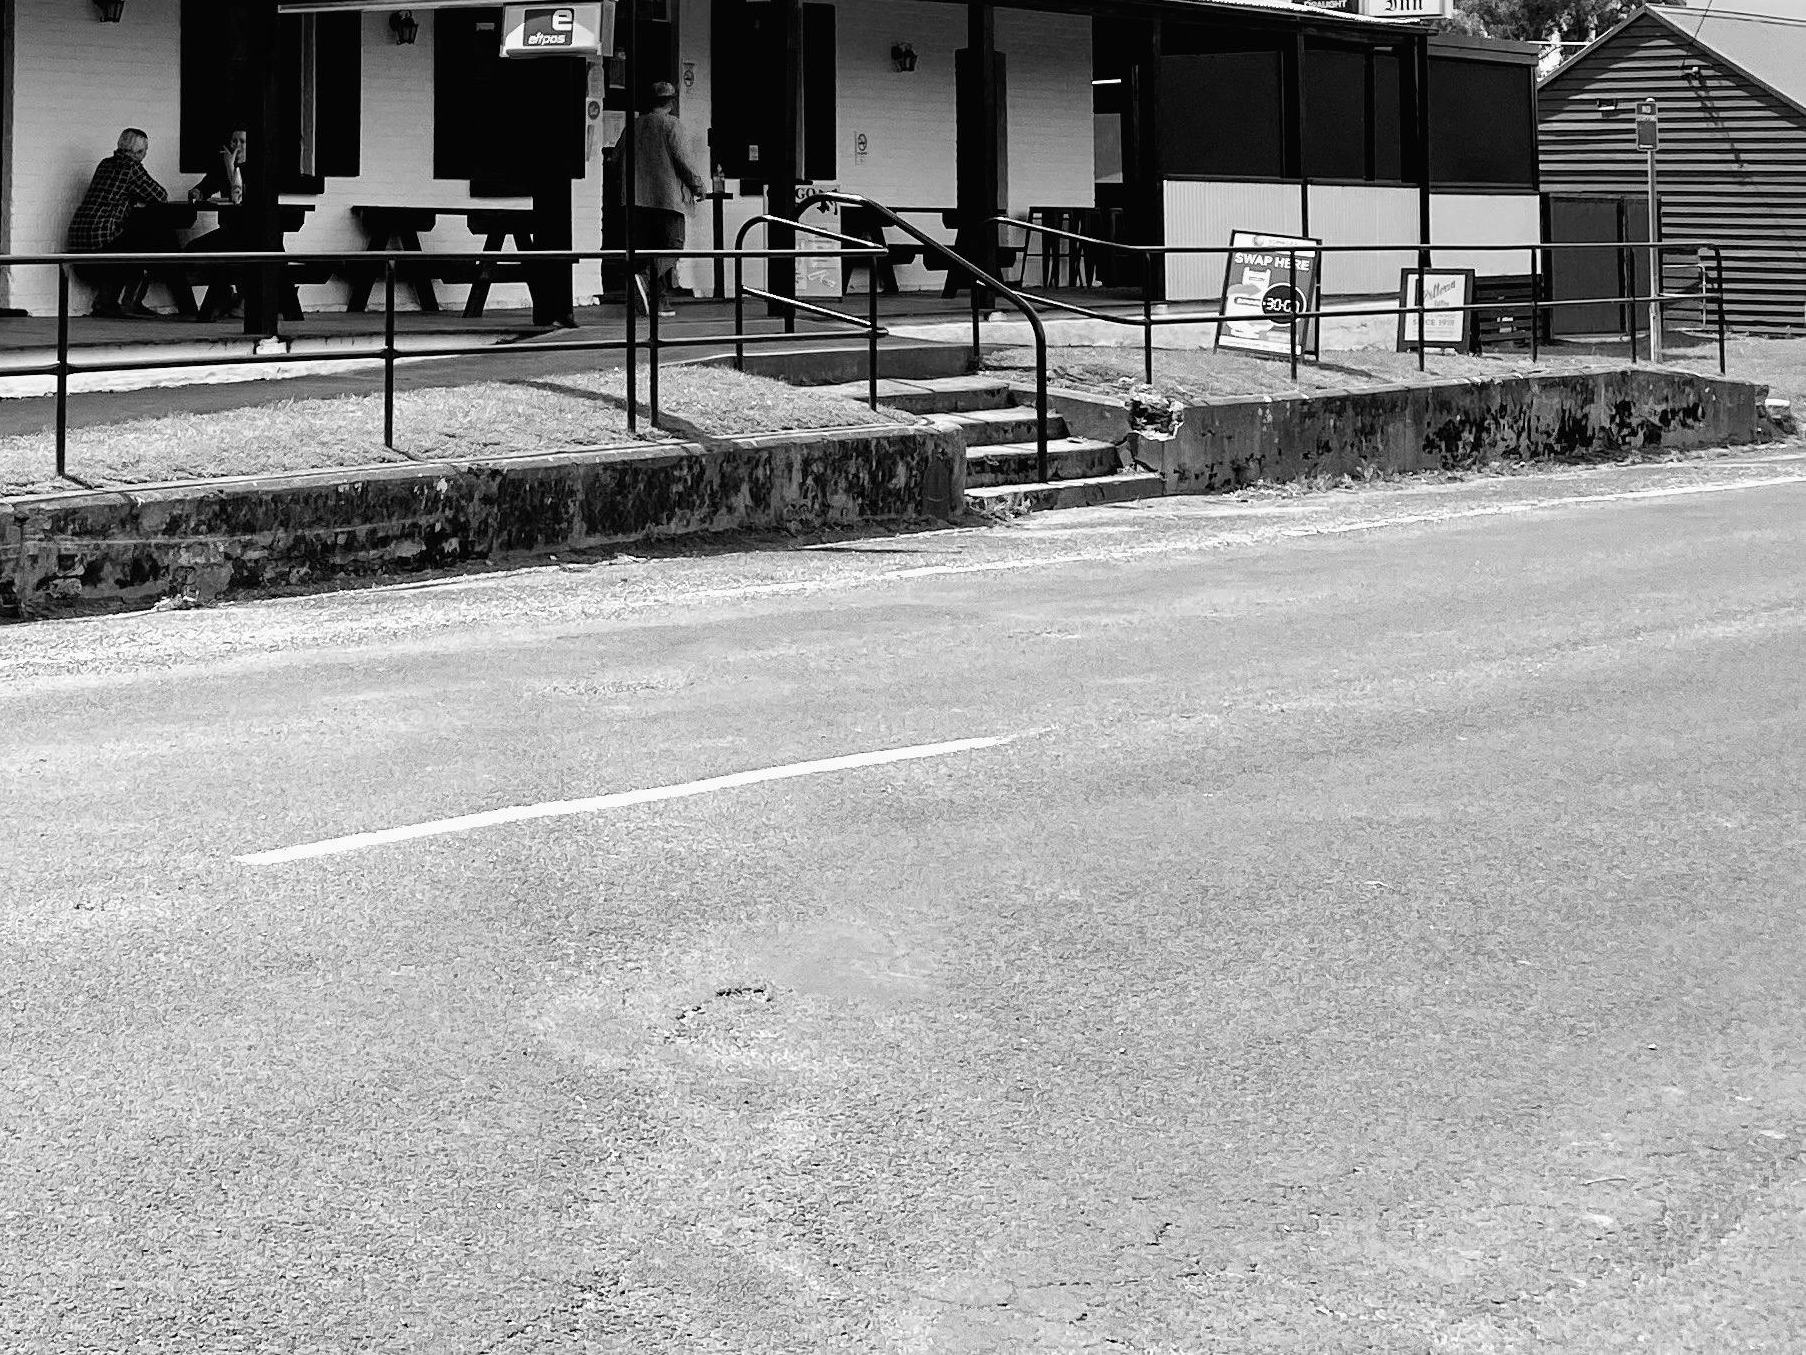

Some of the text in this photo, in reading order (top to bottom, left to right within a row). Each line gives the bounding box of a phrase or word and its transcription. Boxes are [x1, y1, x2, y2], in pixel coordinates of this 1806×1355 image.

[528, 31, 566, 46] eftpos
[1234, 252, 1310, 271] SWAP HERE
